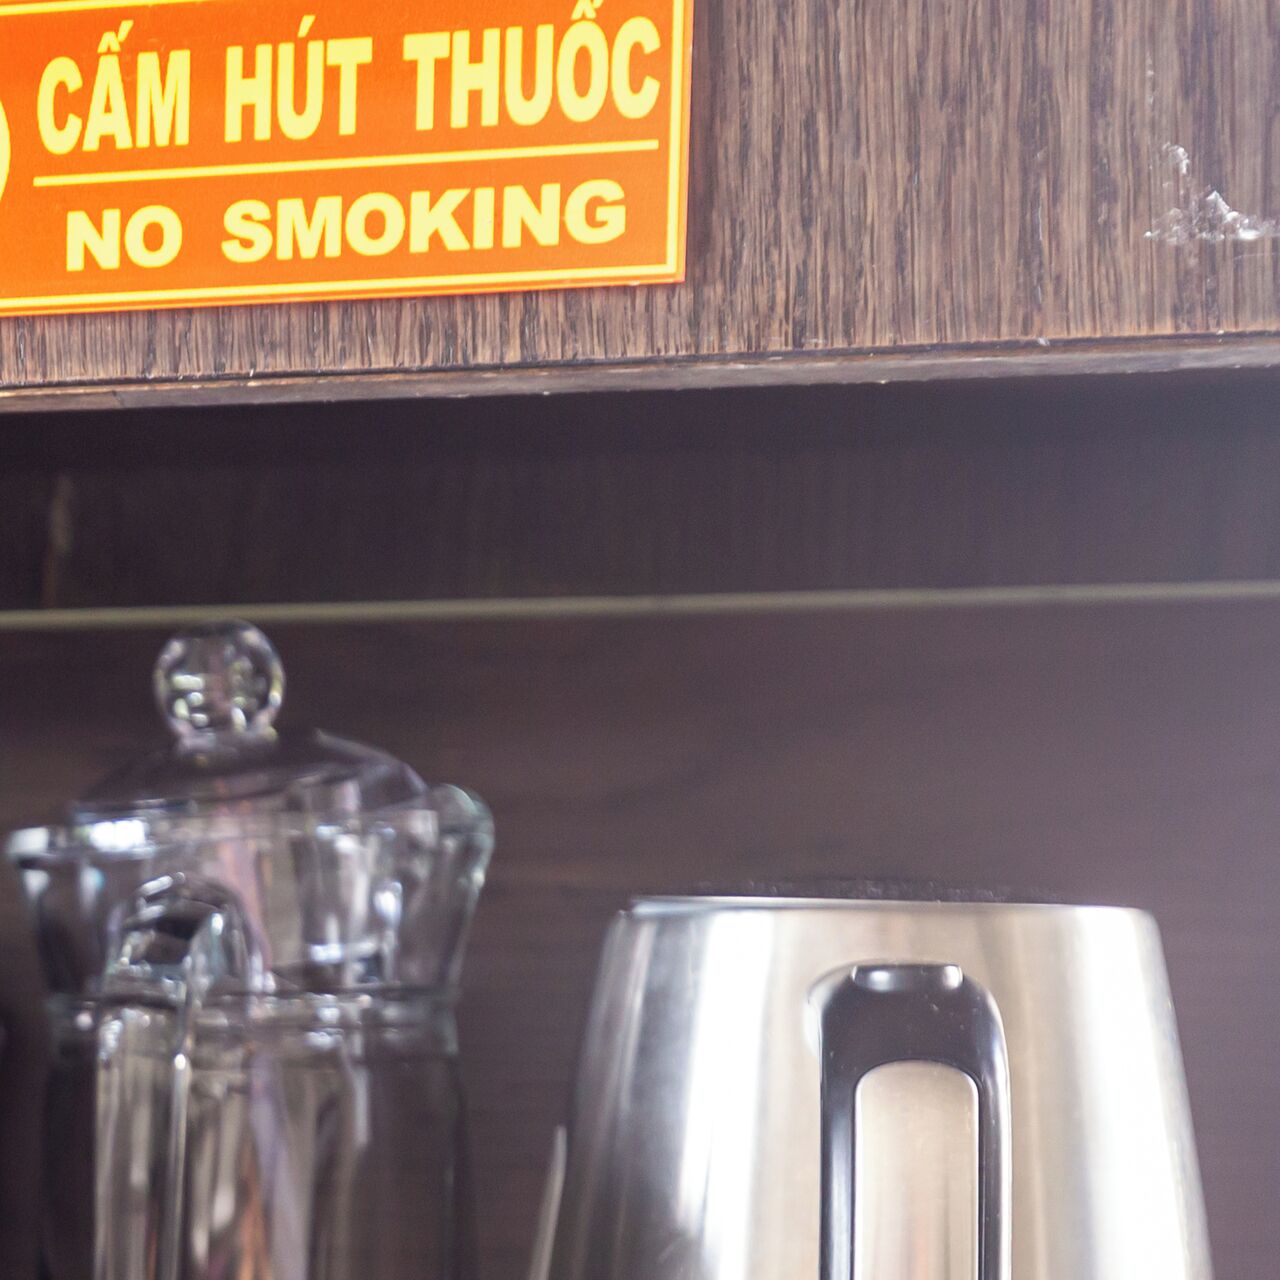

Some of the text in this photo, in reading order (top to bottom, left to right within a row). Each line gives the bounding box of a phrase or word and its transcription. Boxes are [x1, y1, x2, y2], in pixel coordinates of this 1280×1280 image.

[37, 0, 662, 155] CẤM HÚT THUỐC
[66, 180, 627, 272] NO SMOKING
